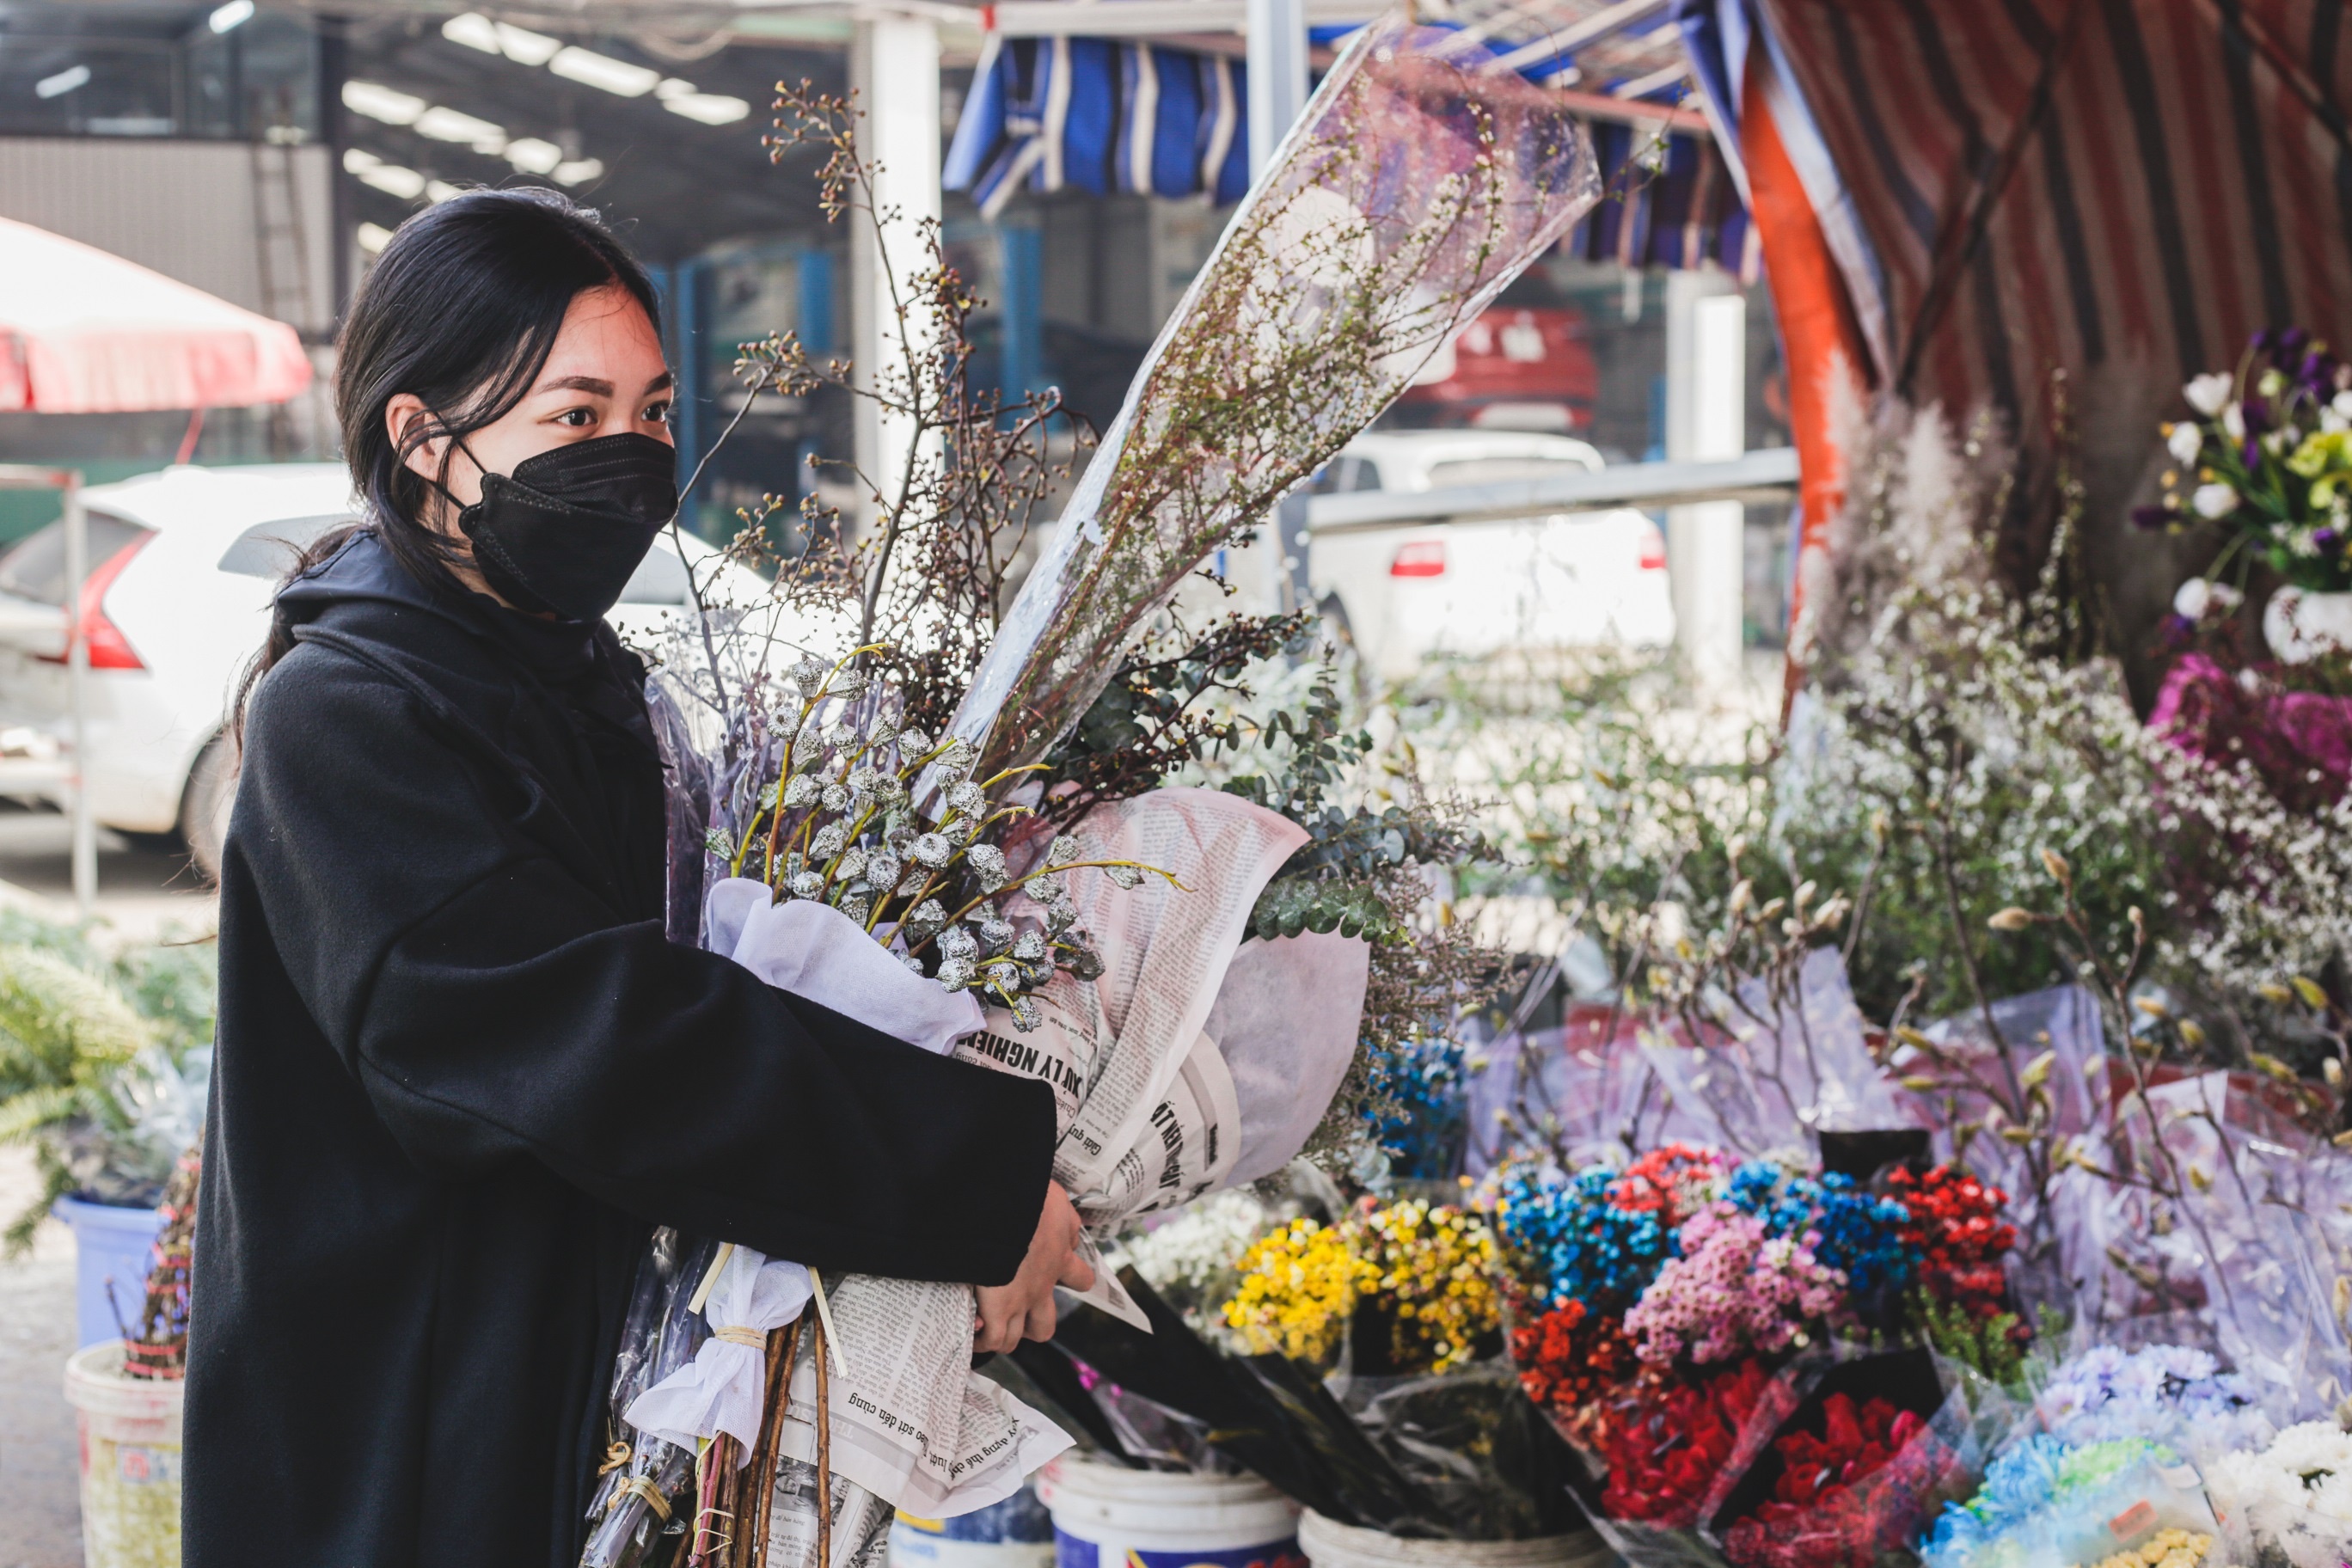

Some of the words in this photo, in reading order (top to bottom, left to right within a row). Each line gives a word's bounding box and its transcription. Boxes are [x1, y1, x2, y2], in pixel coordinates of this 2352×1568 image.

[1082, 1137, 1101, 1155] Giải
[848, 1393, 876, 1413] cùng
[879, 1409, 897, 1428] đến
[898, 1421, 915, 1435] sát
[982, 1438, 1008, 1456] dựng
[963, 1454, 983, 1468] thể
